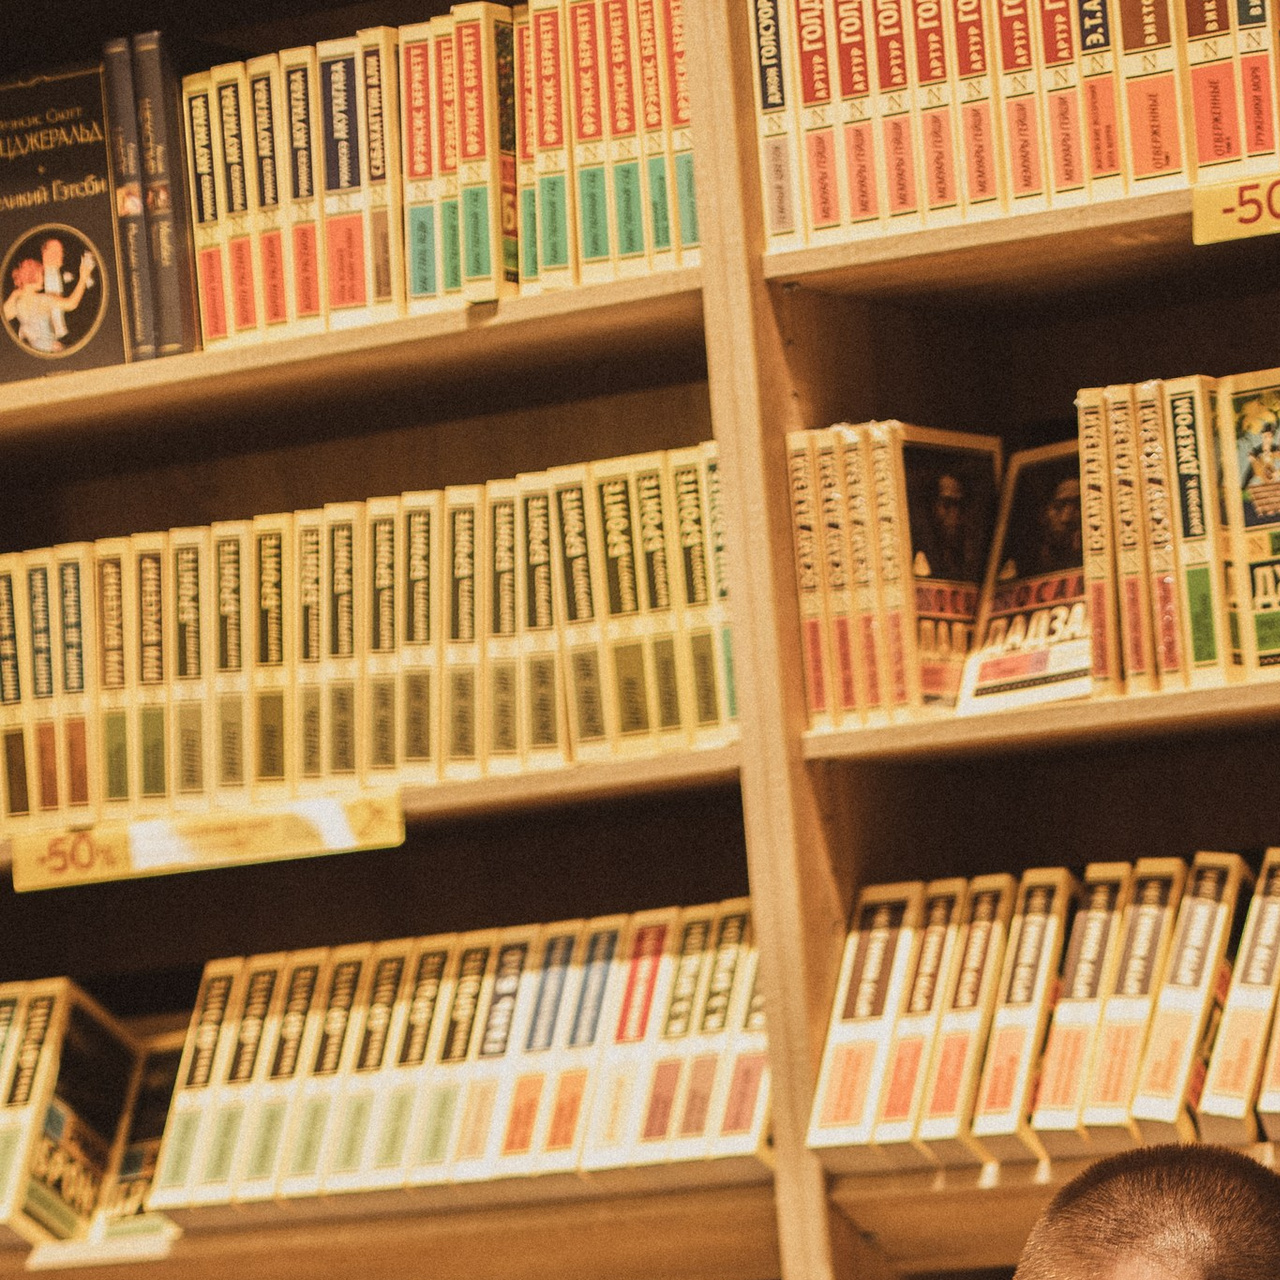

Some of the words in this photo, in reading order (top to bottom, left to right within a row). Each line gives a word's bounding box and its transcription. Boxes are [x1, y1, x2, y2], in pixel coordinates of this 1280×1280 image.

[968, 26, 983, 69] АРТУР
[1013, 21, 1028, 64] АРТУР
[812, 55, 827, 98] АРТУР
